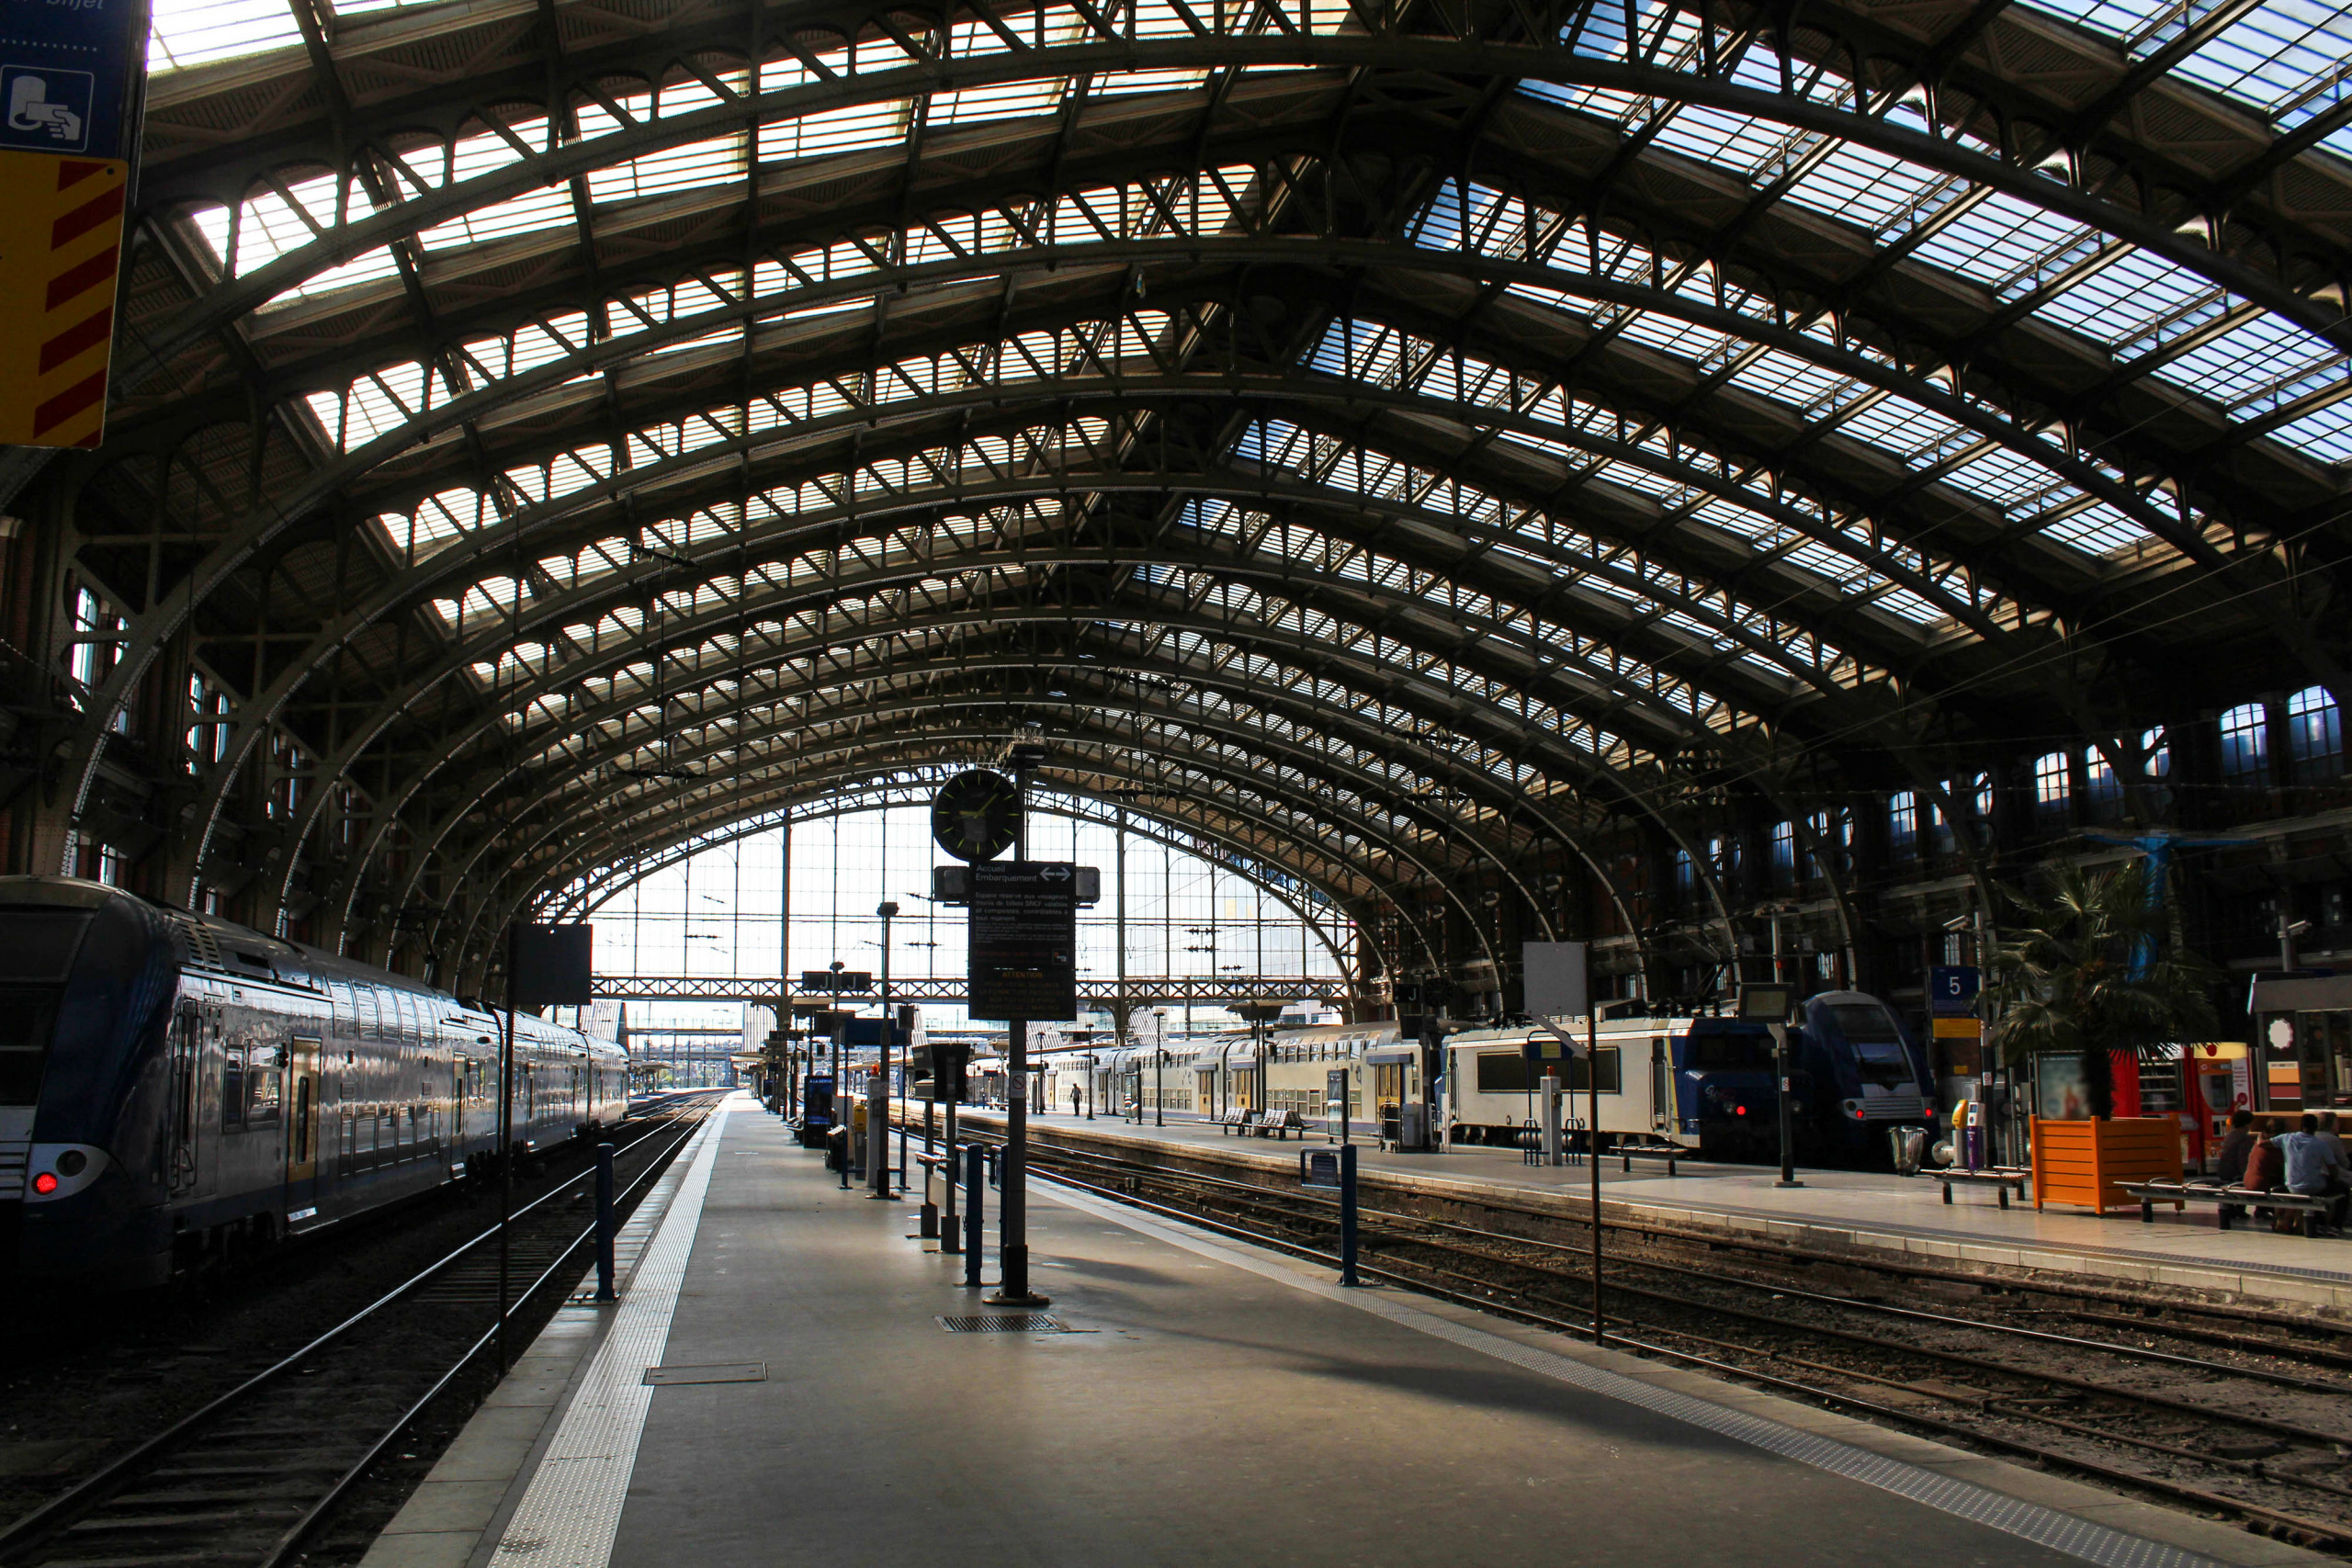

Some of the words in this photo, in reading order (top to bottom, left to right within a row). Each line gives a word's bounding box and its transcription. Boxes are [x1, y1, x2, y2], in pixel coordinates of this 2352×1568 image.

[977, 864, 1006, 873] Accueil
[976, 874, 1037, 884] Embarquement
[820, 976, 829, 989] J
[847, 976, 856, 989] J
[1949, 976, 1961, 995] 5
[1408, 987, 1417, 1001] J
